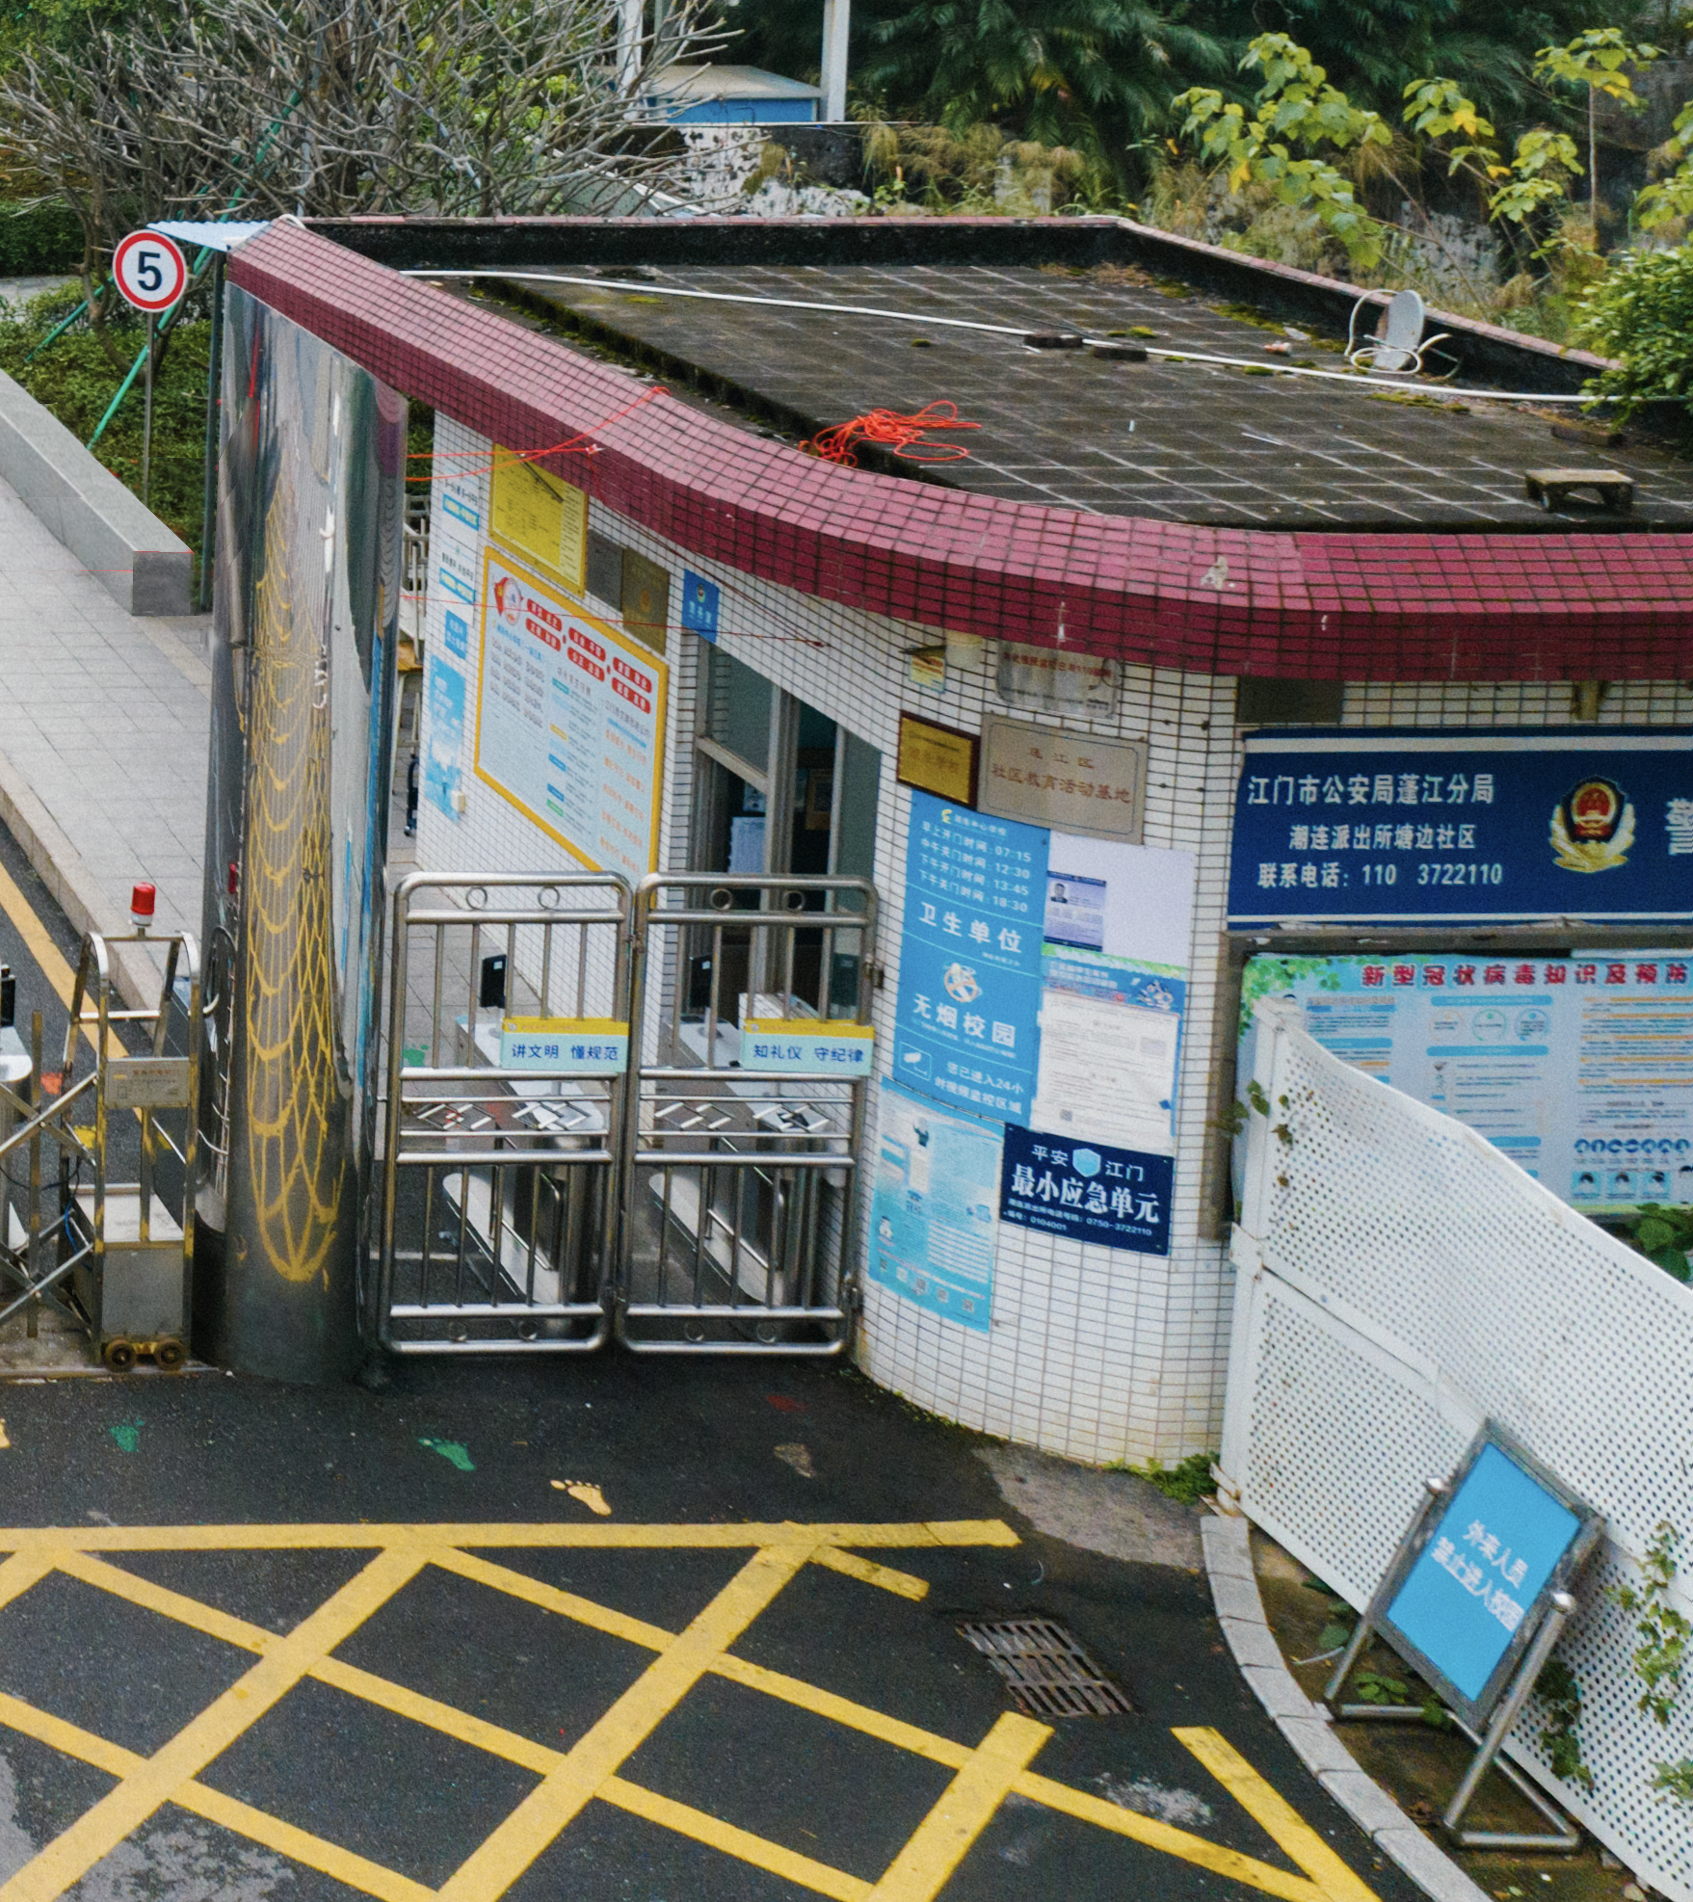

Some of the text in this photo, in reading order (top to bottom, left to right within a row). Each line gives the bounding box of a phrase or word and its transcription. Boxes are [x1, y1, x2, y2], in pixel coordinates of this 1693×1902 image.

[137, 251, 163, 291] 5
[991, 763, 1131, 804] 社区教育活动基地
[1247, 774, 1494, 805] 江门市公安局蓬江分局
[1289, 824, 1477, 850] 潮连派出所塘边社区
[1362, 864, 1397, 886] 110
[1417, 863, 1503, 886] 3722110
[918, 901, 1022, 953] 卫生单位
[1361, 964, 1691, 987] 新型冠状病毒知识及预防
[913, 992, 1016, 1049] 无烟校园
[511, 1043, 619, 1061] 讲文明 懂规范
[753, 1044, 865, 1063] 知礼仪 守纪律
[934, 1075, 1022, 1115] 时视频监控区域
[1031, 1144, 1144, 1182] 平安 江门
[1011, 1163, 1160, 1224] 最小应急单元
[1461, 1518, 1530, 1590] 外来人员
[1430, 1536, 1525, 1633] 禁止进入校园
